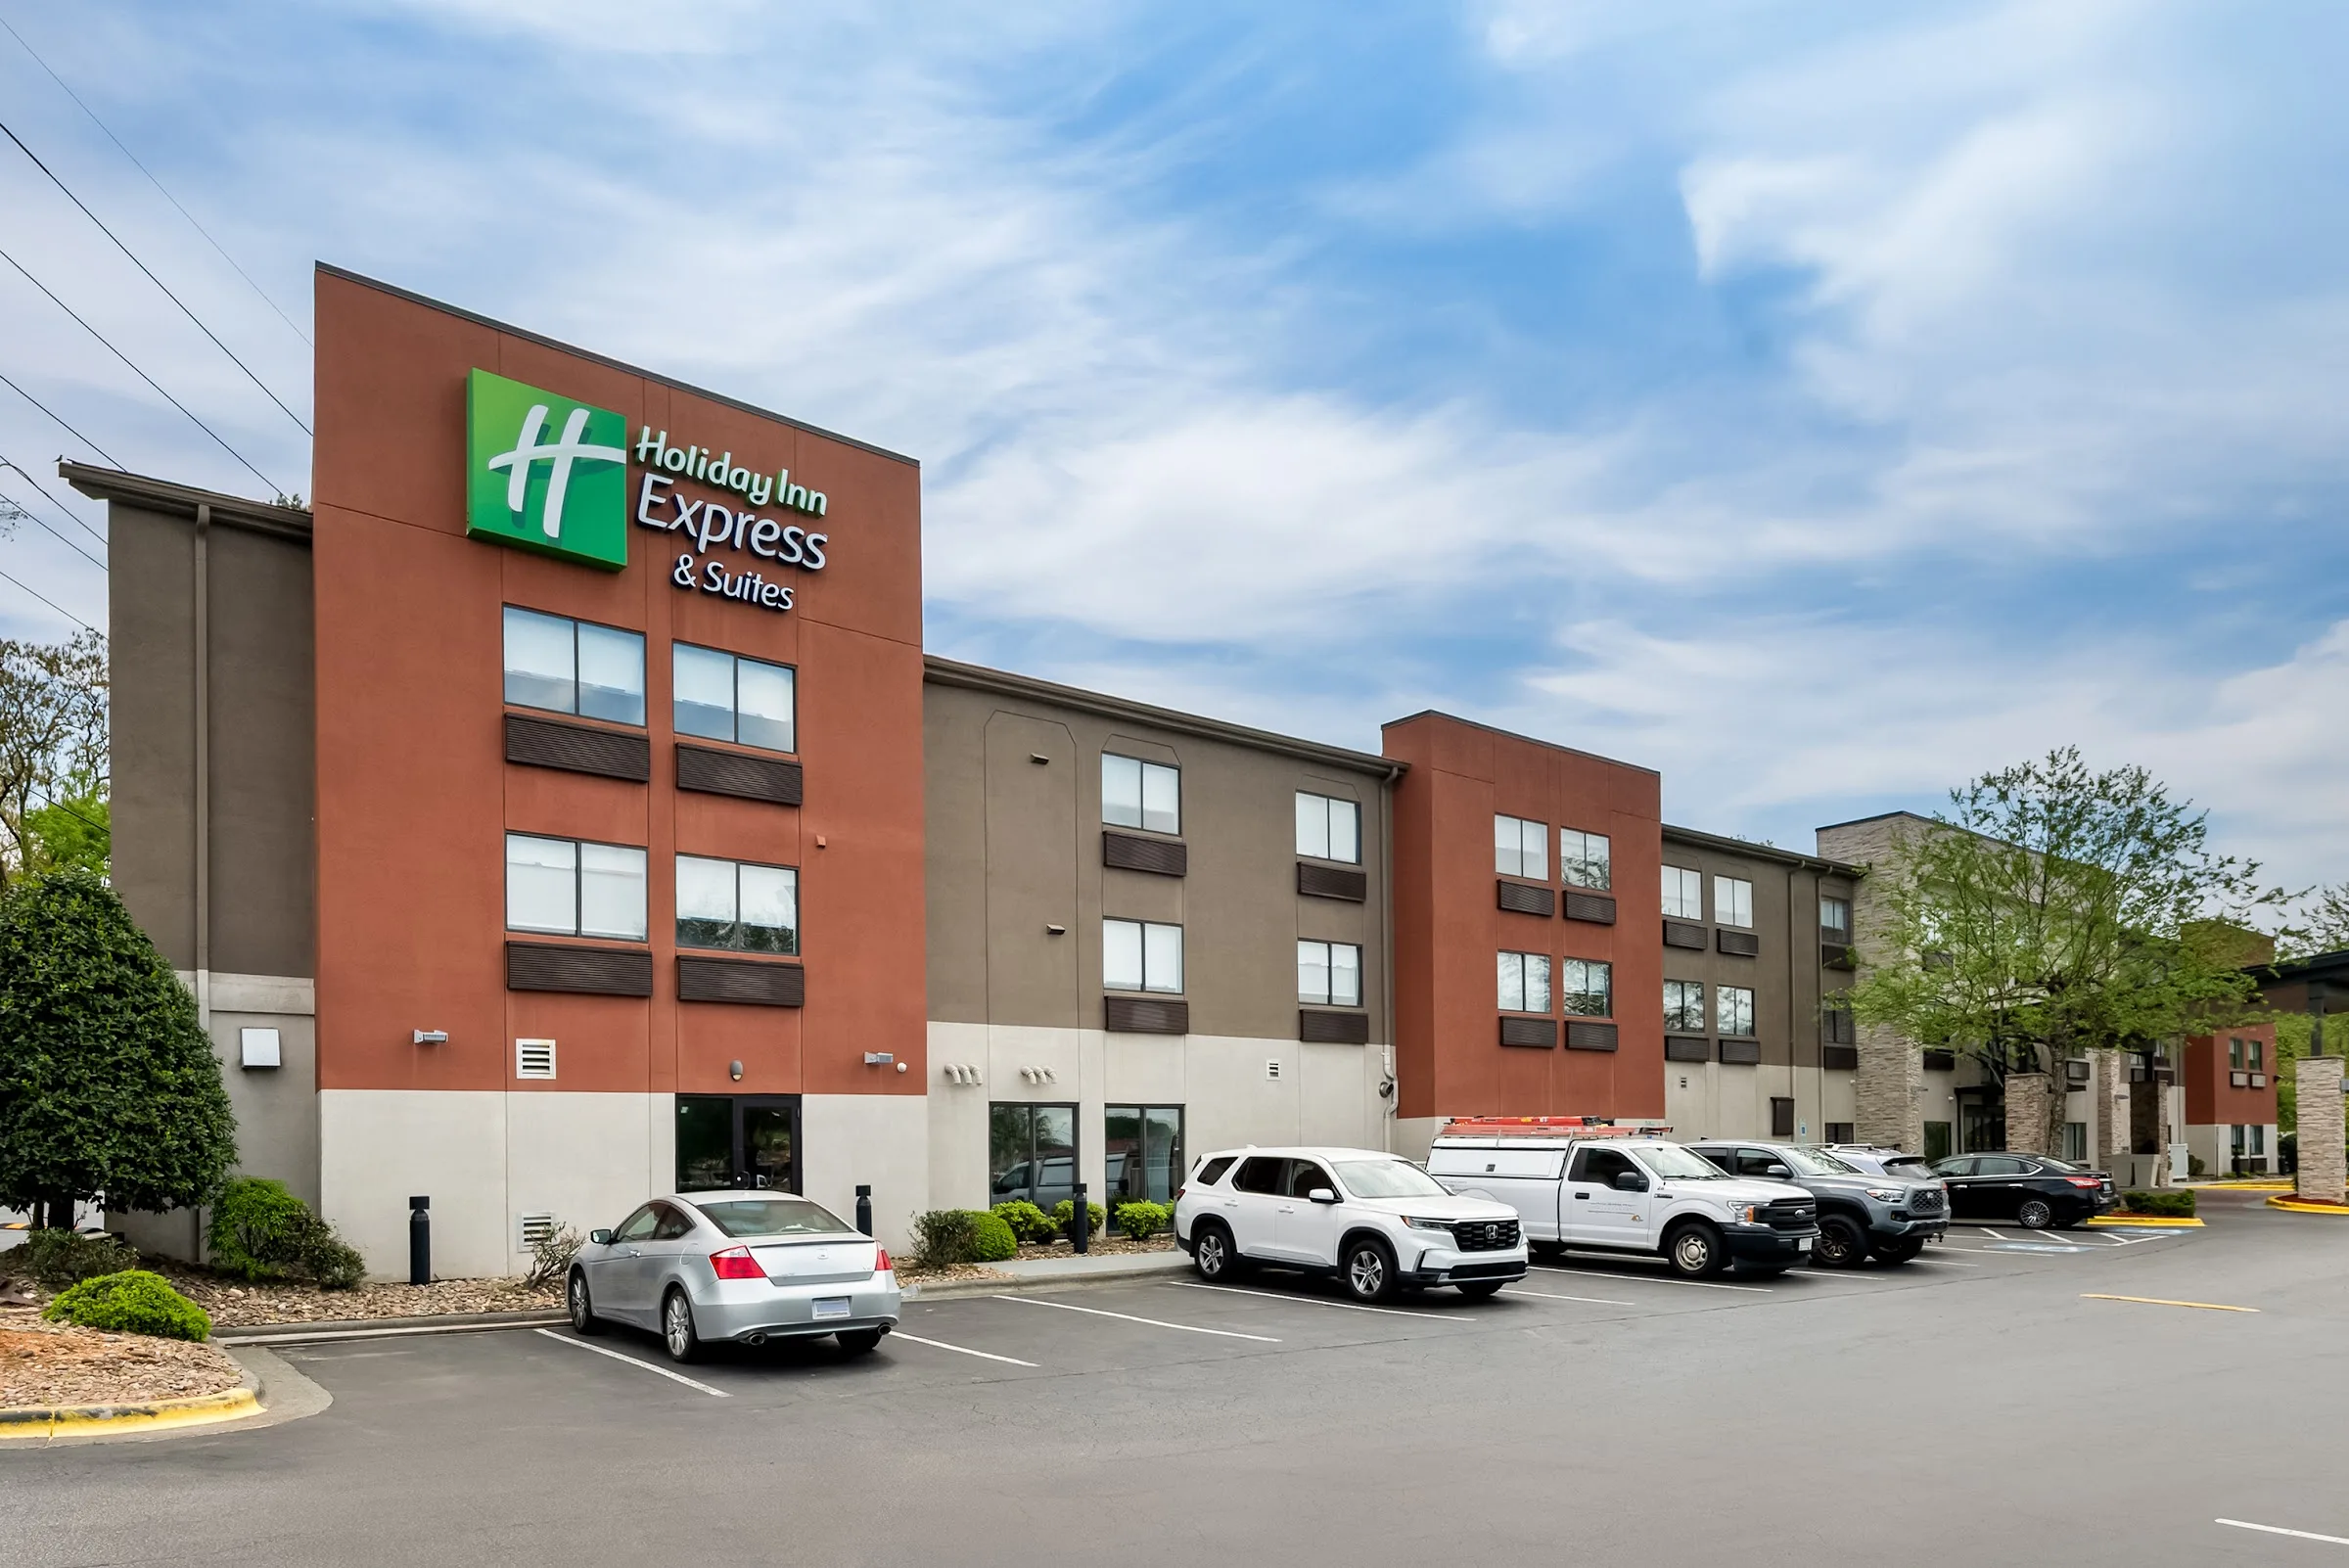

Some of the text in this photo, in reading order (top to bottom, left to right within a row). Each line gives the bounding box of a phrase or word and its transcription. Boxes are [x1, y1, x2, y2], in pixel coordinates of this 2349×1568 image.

[635, 425, 828, 517] Holiday Inn
[637, 472, 829, 571] Express
[673, 553, 795, 611] & Suites
